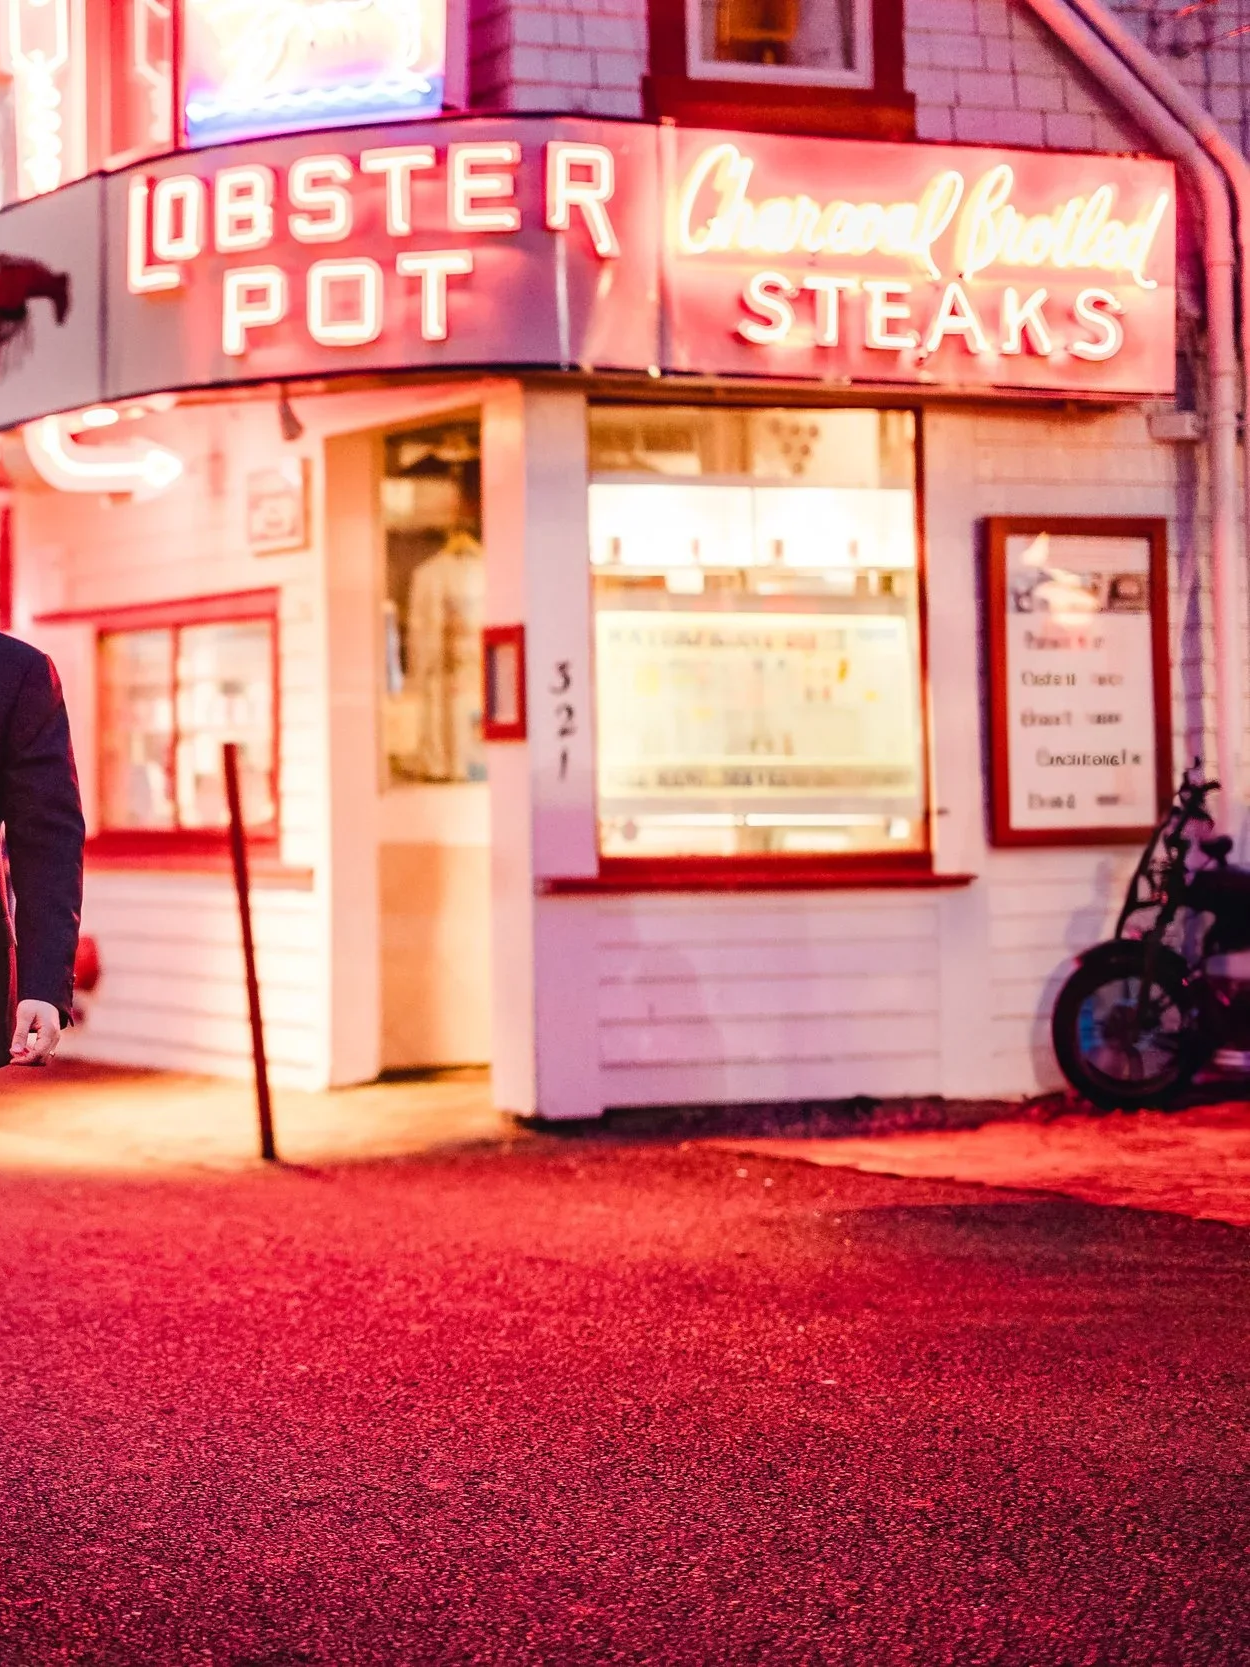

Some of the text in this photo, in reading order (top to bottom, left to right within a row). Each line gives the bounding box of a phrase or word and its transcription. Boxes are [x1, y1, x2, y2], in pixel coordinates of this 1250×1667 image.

[126, 141, 620, 295] LOBSTER
[679, 142, 964, 280] Charcoal
[221, 248, 474, 356] POT
[736, 271, 1125, 362] STEAKS
[549, 660, 576, 781] 321
